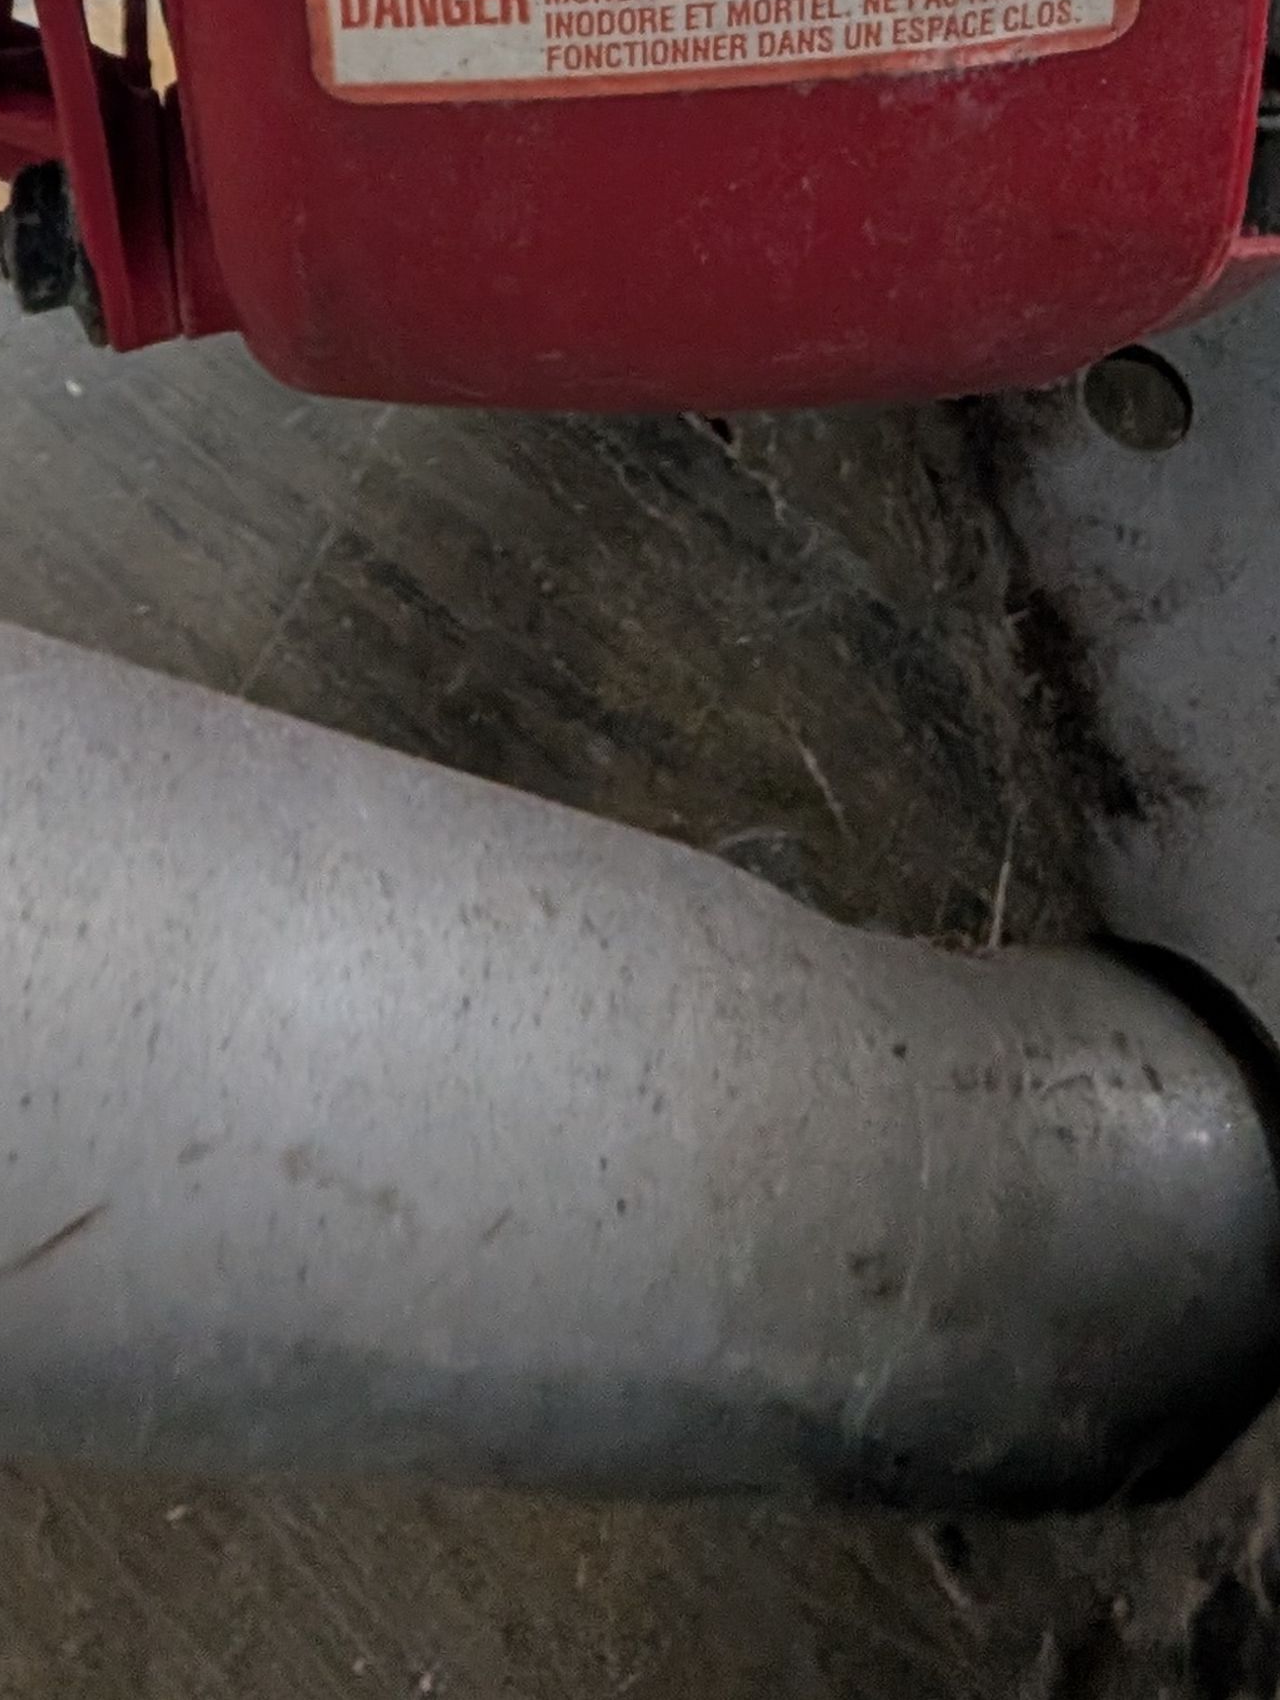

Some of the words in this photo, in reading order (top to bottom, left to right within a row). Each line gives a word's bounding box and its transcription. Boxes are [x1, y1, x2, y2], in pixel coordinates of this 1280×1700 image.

[545, 2, 676, 39] INODORE
[685, 0, 718, 32] ET
[546, 31, 748, 72] FONCTIONNER
[757, 27, 834, 58] DANS
[843, 20, 882, 50] UN
[892, 7, 996, 45] ESPACE
